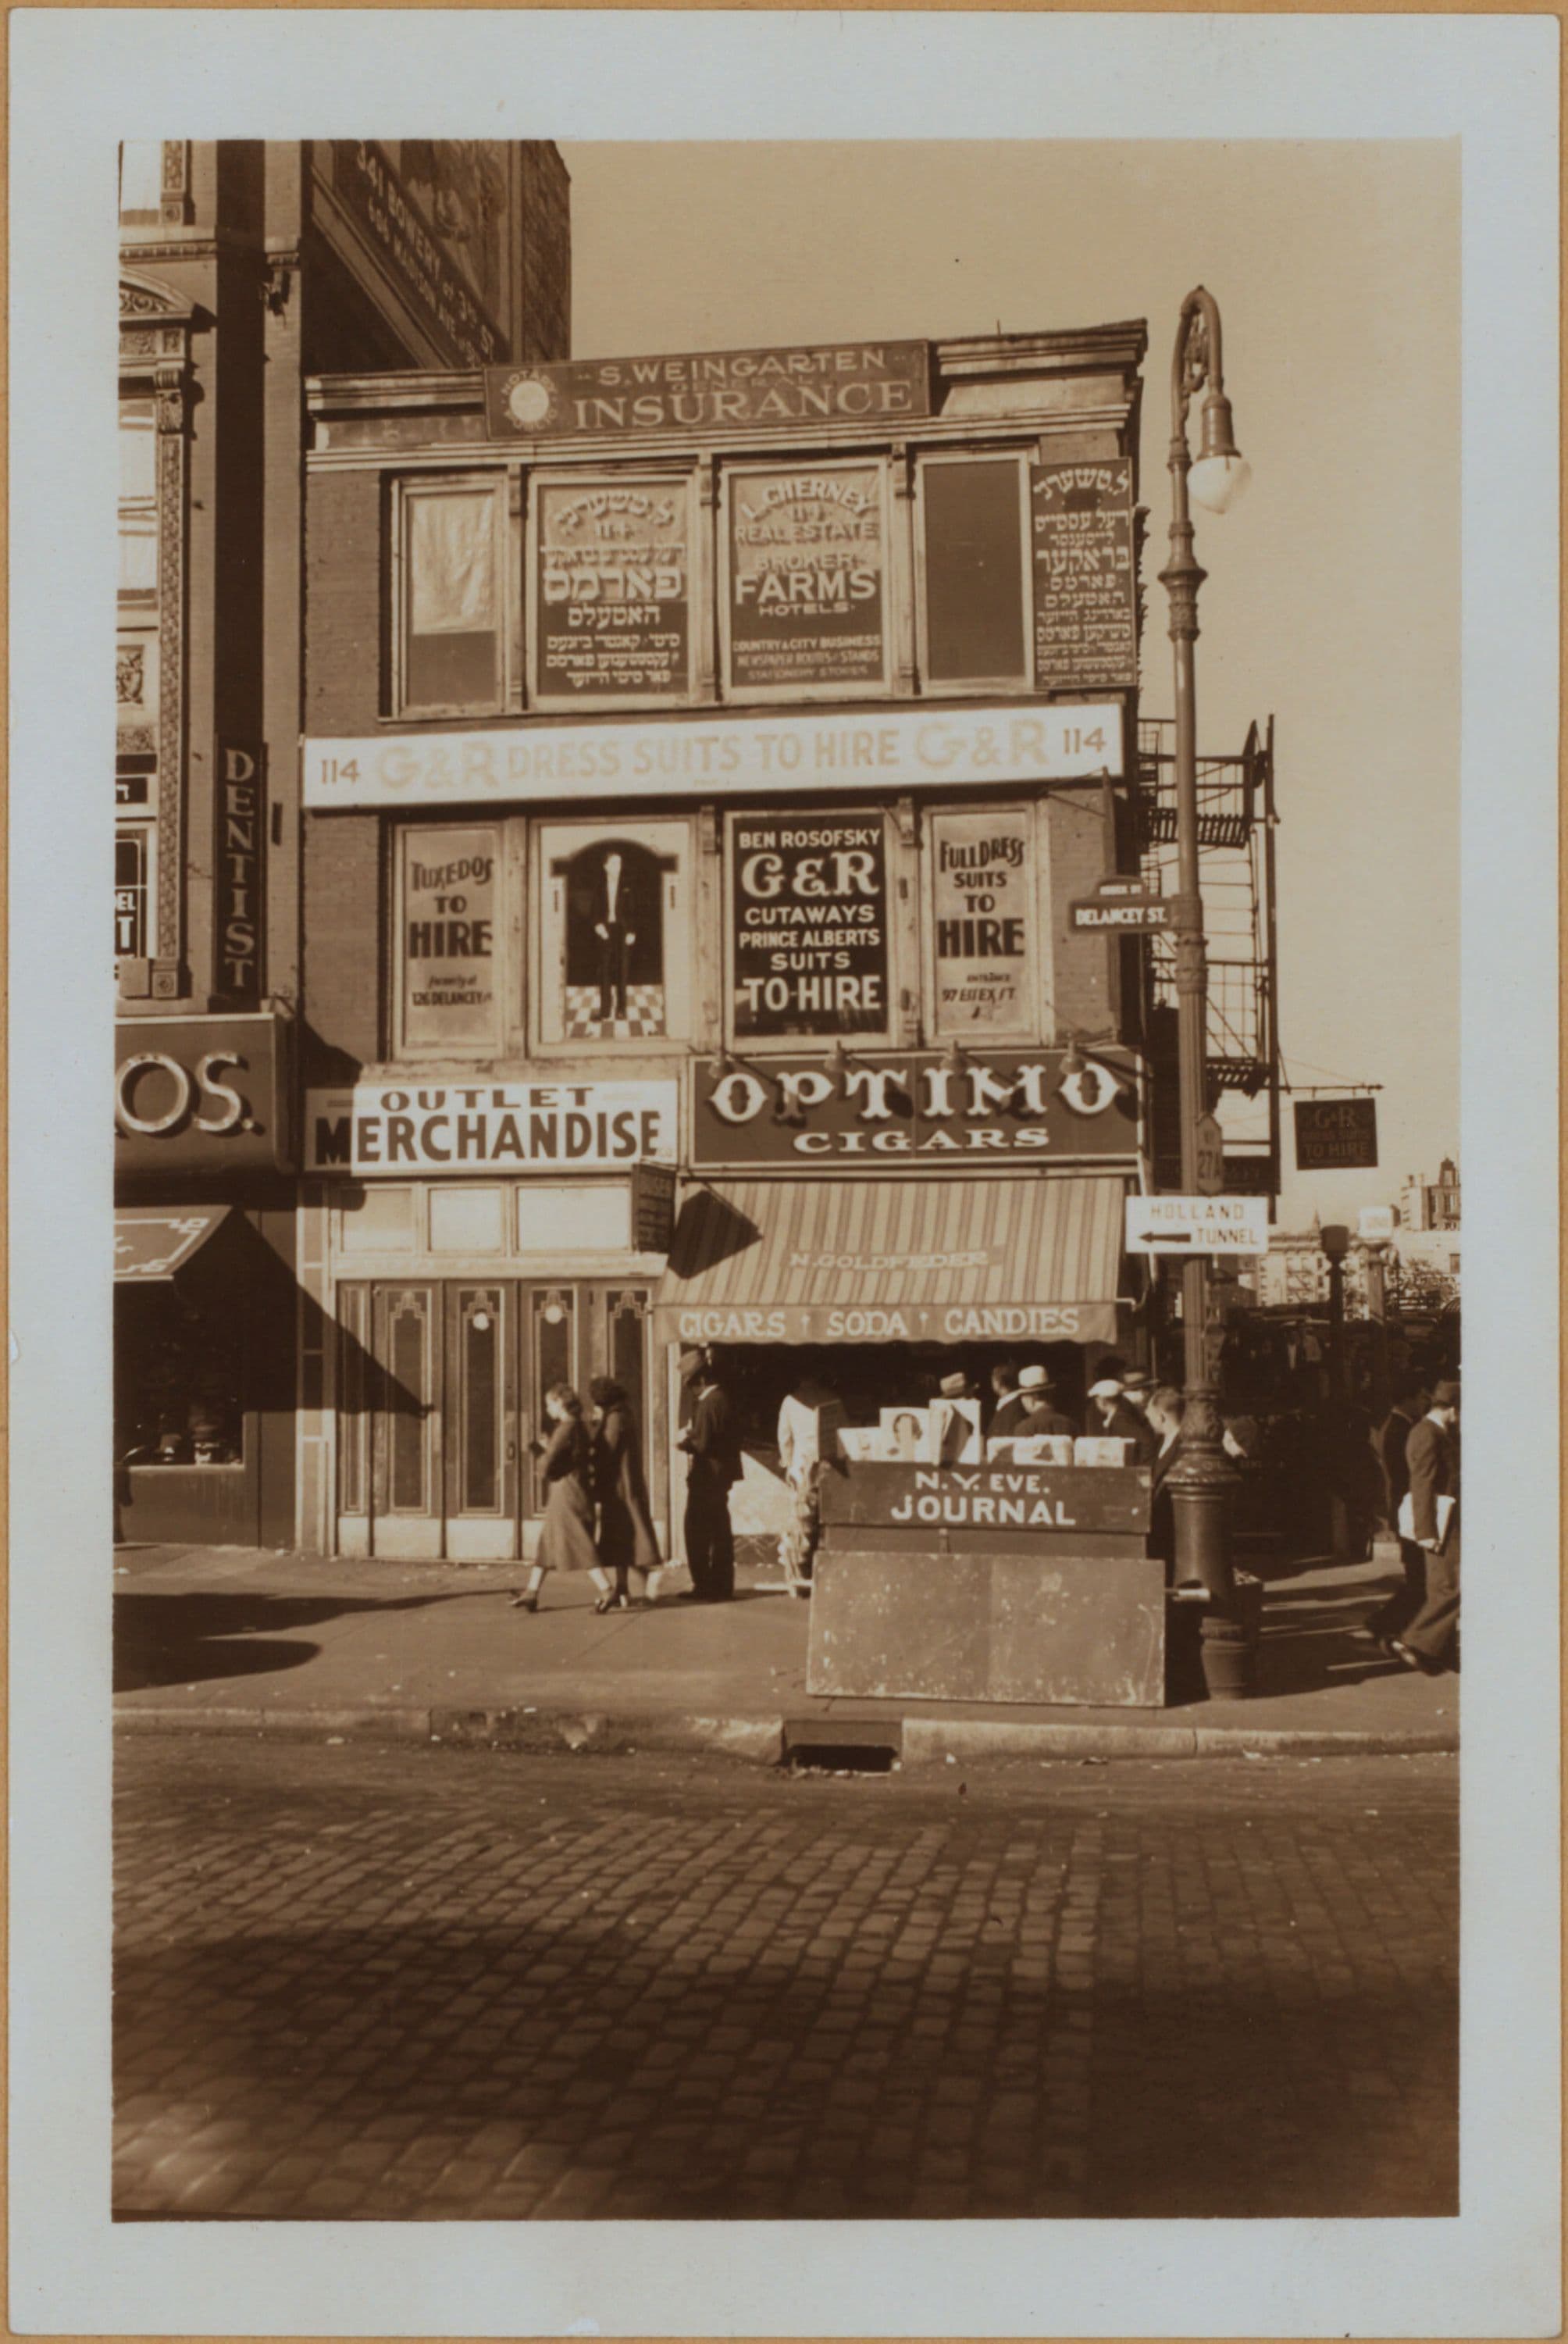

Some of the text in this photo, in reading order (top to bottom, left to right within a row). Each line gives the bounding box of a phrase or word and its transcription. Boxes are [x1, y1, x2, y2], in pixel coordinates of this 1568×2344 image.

[672, 375, 814, 391] GENERAL
[574, 380, 912, 430] INSURANCE
[762, 476, 873, 517] CHERNEY
[736, 519, 880, 547] REAL ESTATE
[543, 567, 682, 600] פארמס
[736, 568, 876, 605] FARMS
[568, 600, 661, 630] האטעלס
[758, 601, 850, 617] HOTELS
[320, 757, 359, 785] 114
[508, 739, 622, 781] DRESS
[633, 734, 740, 776] SUITS
[755, 731, 803, 772] TO
[814, 728, 900, 769] HIRE
[1063, 726, 1107, 755] 114
[739, 828, 881, 850] BEN ROSOFSKY
[224, 748, 256, 988] DENTIST
[410, 857, 494, 892] TUXEDOS
[742, 849, 881, 898] G&R
[953, 870, 1007, 889] SUITS
[435, 895, 467, 915] TO
[744, 904, 876, 926] CUTAWAYS
[964, 894, 996, 913] TO
[1075, 907, 1146, 926] DELANCEY
[409, 916, 494, 959] HIRE
[739, 928, 881, 950] PRINCE ALBERTS
[938, 916, 1025, 958] HIRE
[770, 951, 851, 972] SUITS
[380, 1086, 594, 1112] OUTLET
[709, 1062, 1121, 1123] OPTIMO
[315, 1110, 661, 1166] MERCHANDISE
[793, 1127, 1050, 1154] CIGARS
[1328, 1143, 1369, 1158] HIRE
[1150, 1203, 1245, 1222] HOLLAND
[1196, 1227, 1258, 1245] TUNNEL
[678, 1308, 1080, 1338] CIGARS SODA CANDIES
[989, 1472, 1051, 1494] EVE.
[889, 1494, 1077, 1526] JOURNAL
